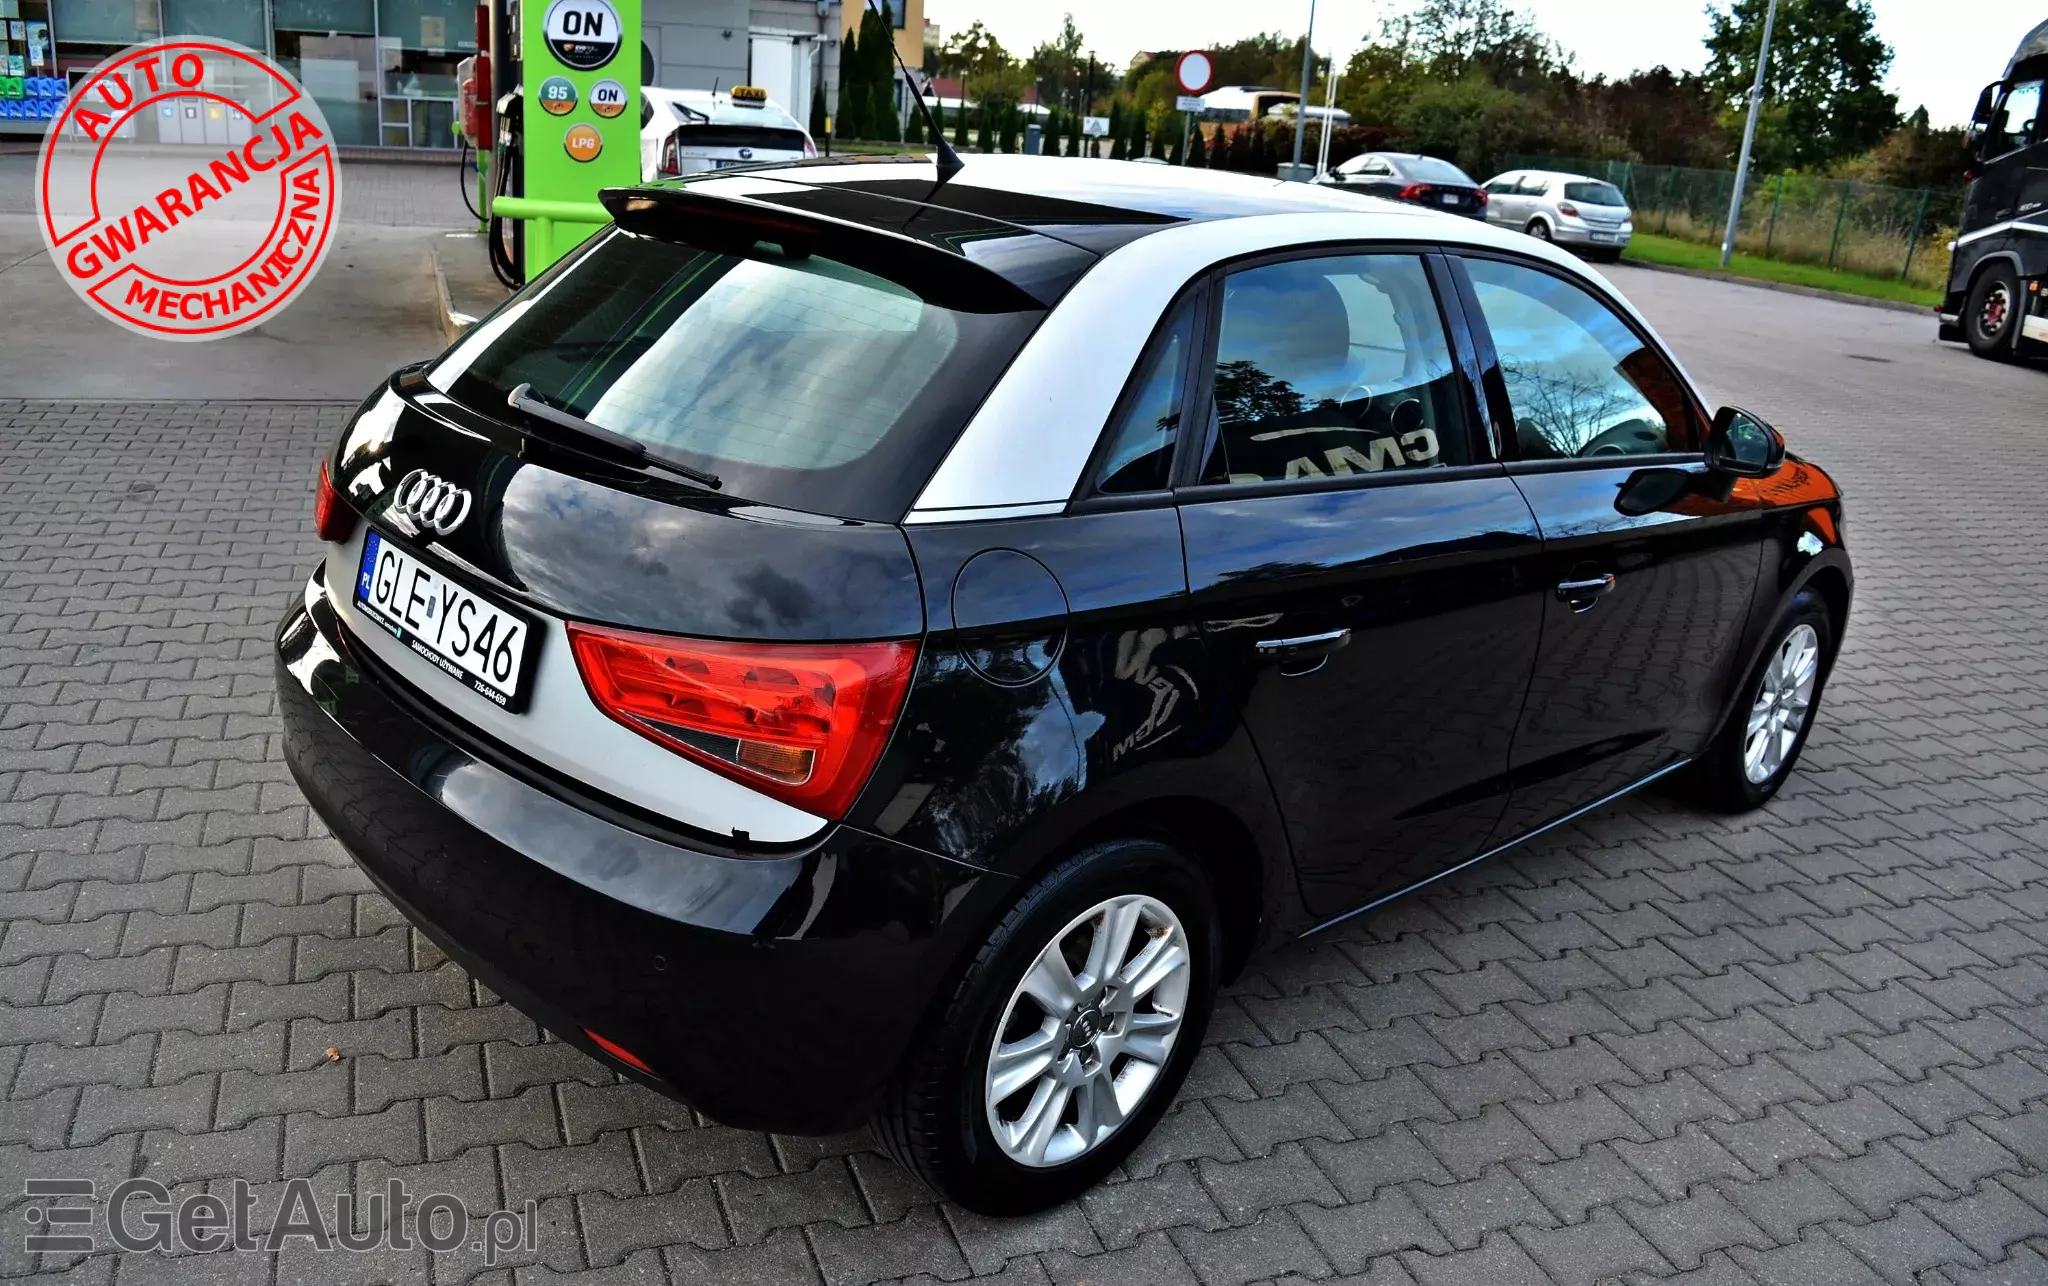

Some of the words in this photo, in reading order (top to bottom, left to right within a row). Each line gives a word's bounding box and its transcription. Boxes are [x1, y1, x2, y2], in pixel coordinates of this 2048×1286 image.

[563, 10, 604, 37] ON
[548, 85, 568, 100] 95
[597, 88, 619, 102] ON
[739, 87, 765, 98] TAXI
[572, 136, 595, 149] LPG
[361, 571, 371, 590] PL
[376, 550, 431, 630] GLE
[437, 583, 519, 683] YS46
[411, 639, 441, 664] SAMOCHODY
[439, 657, 464, 680] UŻYWANE
[473, 680, 507, 706] 726-644-659
